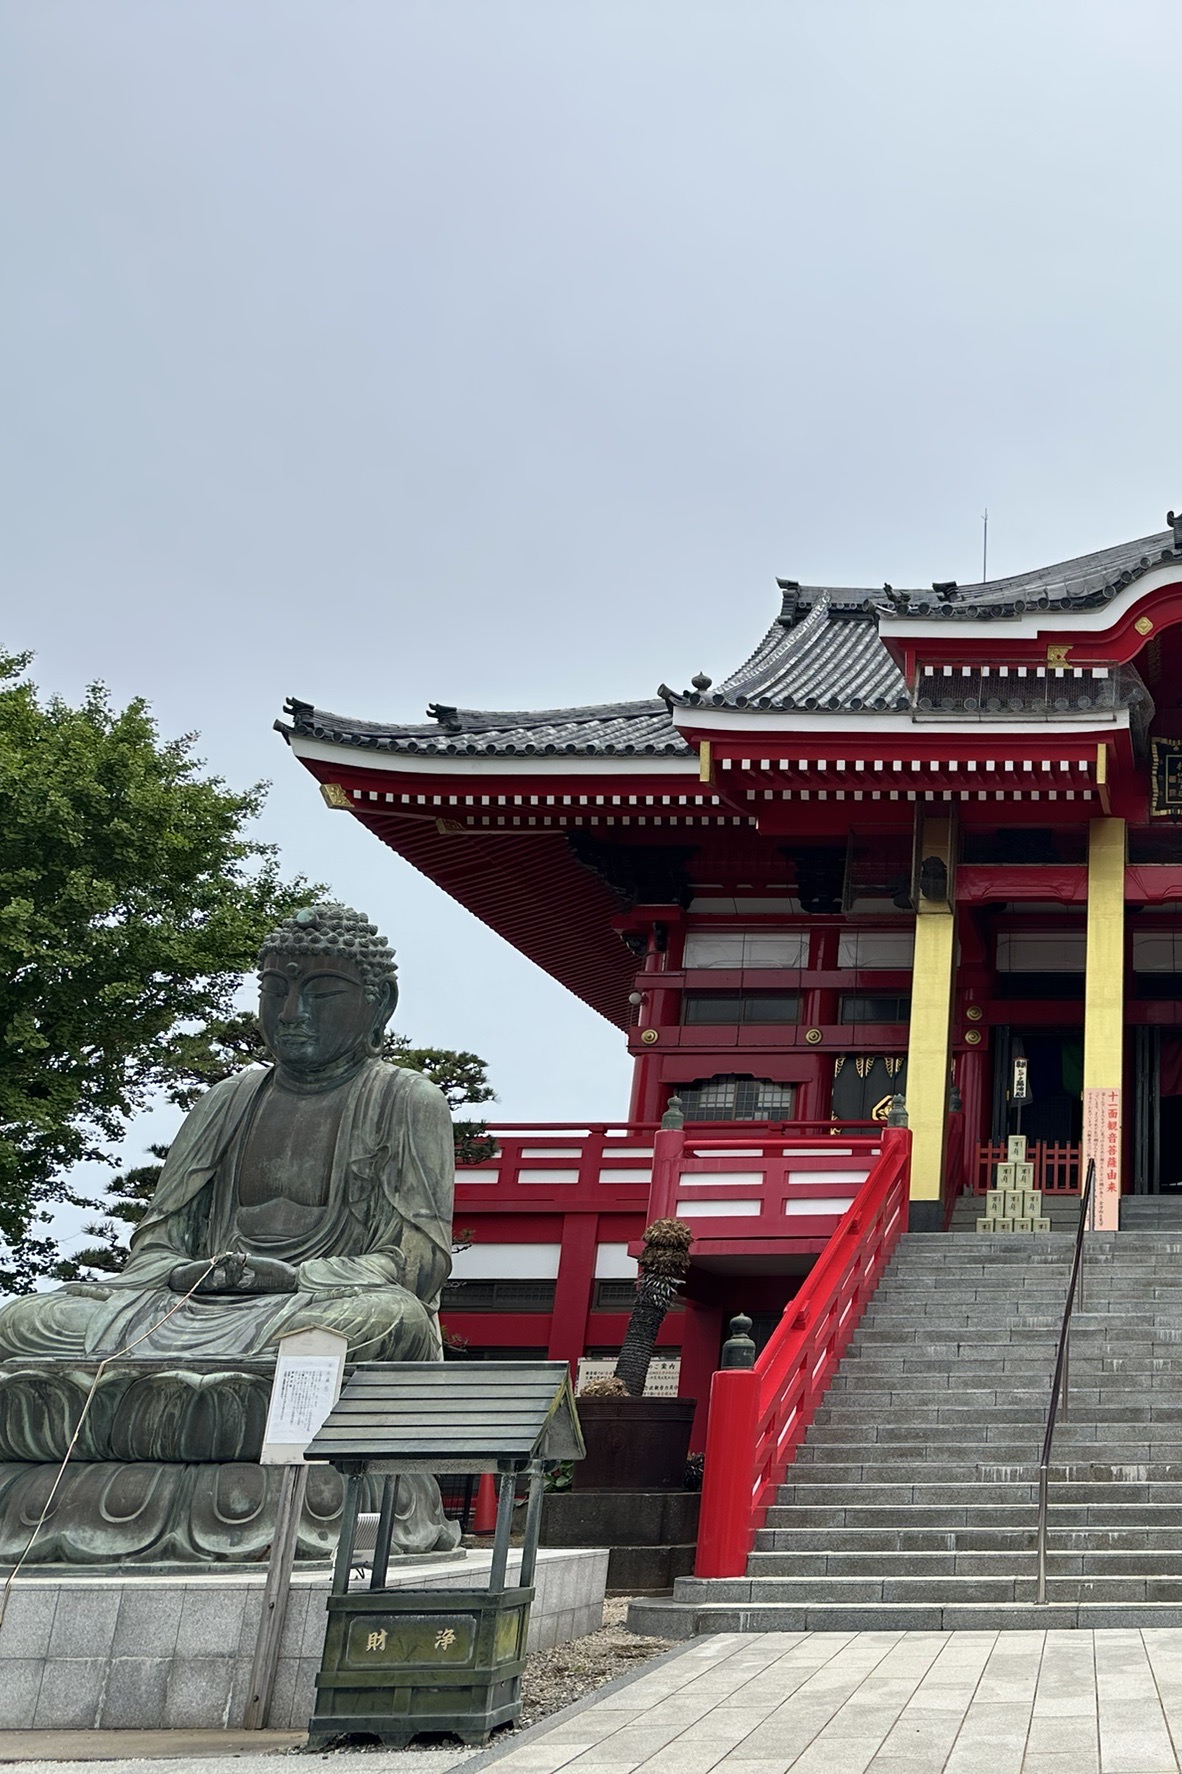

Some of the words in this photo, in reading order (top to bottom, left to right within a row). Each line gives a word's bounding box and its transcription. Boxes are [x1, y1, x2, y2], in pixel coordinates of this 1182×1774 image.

[1107, 1091, 1119, 1193] 十一面観音菩薩由来
